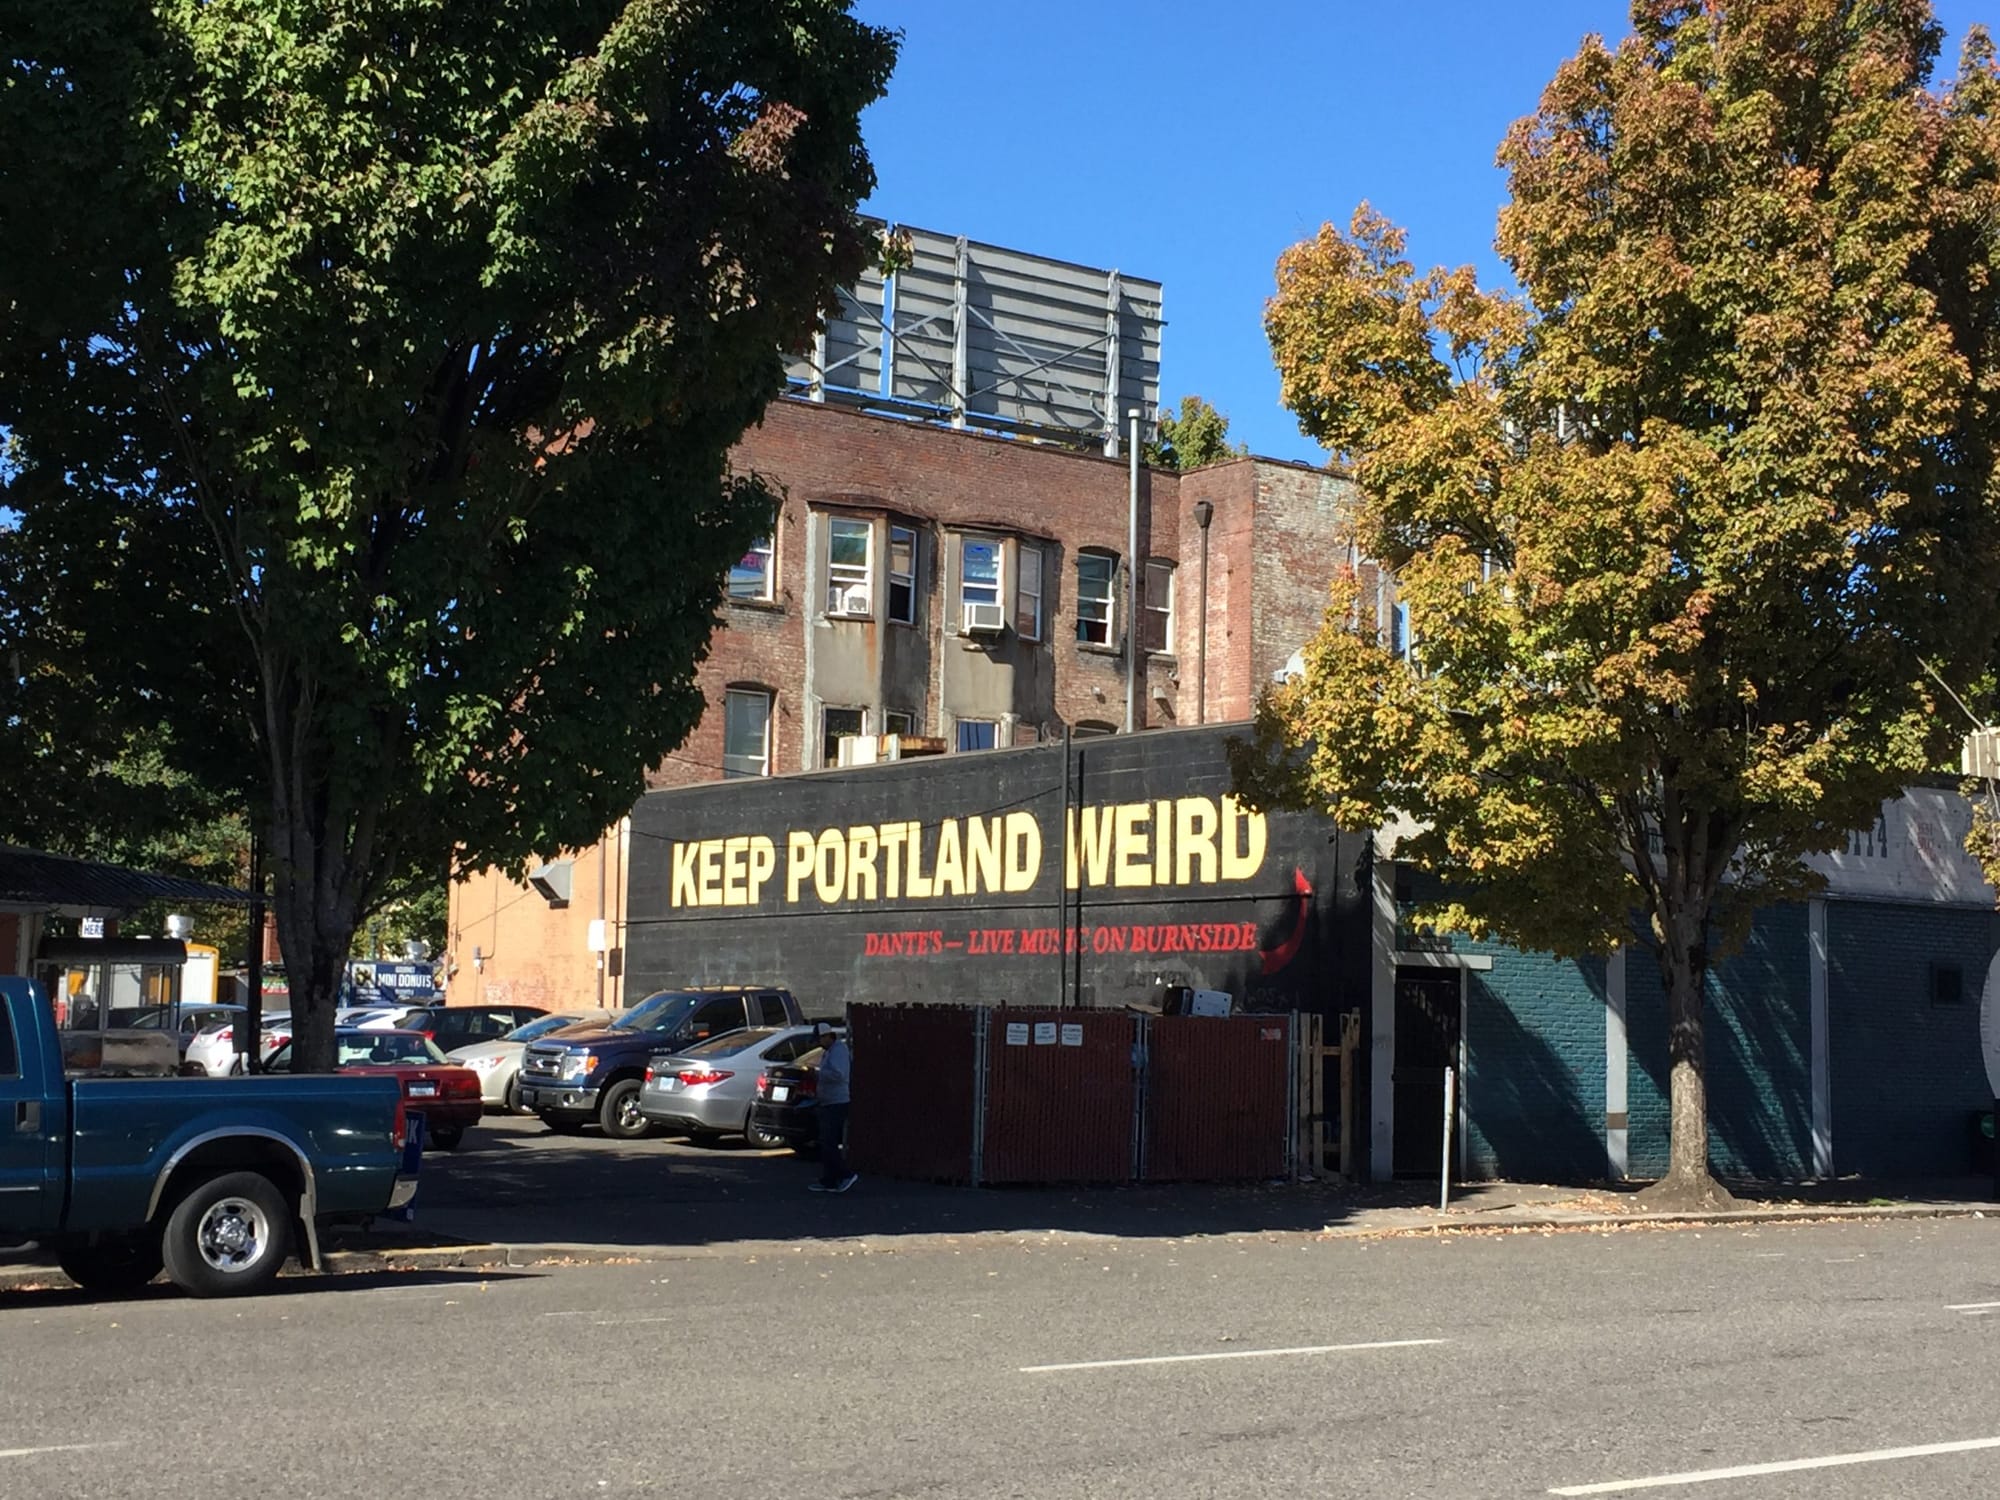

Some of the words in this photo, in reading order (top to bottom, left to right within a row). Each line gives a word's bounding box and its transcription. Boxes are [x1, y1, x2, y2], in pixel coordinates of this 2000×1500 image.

[671, 836, 776, 907] KEEP
[787, 812, 1042, 904] PORTLAND
[1065, 793, 1267, 889] WEIRD
[968, 929, 1015, 954] LIVE
[1092, 926, 1128, 954] ON
[1130, 923, 1257, 953] BURNSIDE
[378, 973, 397, 987] MINI
[398, 974, 432, 988] DONUTS
